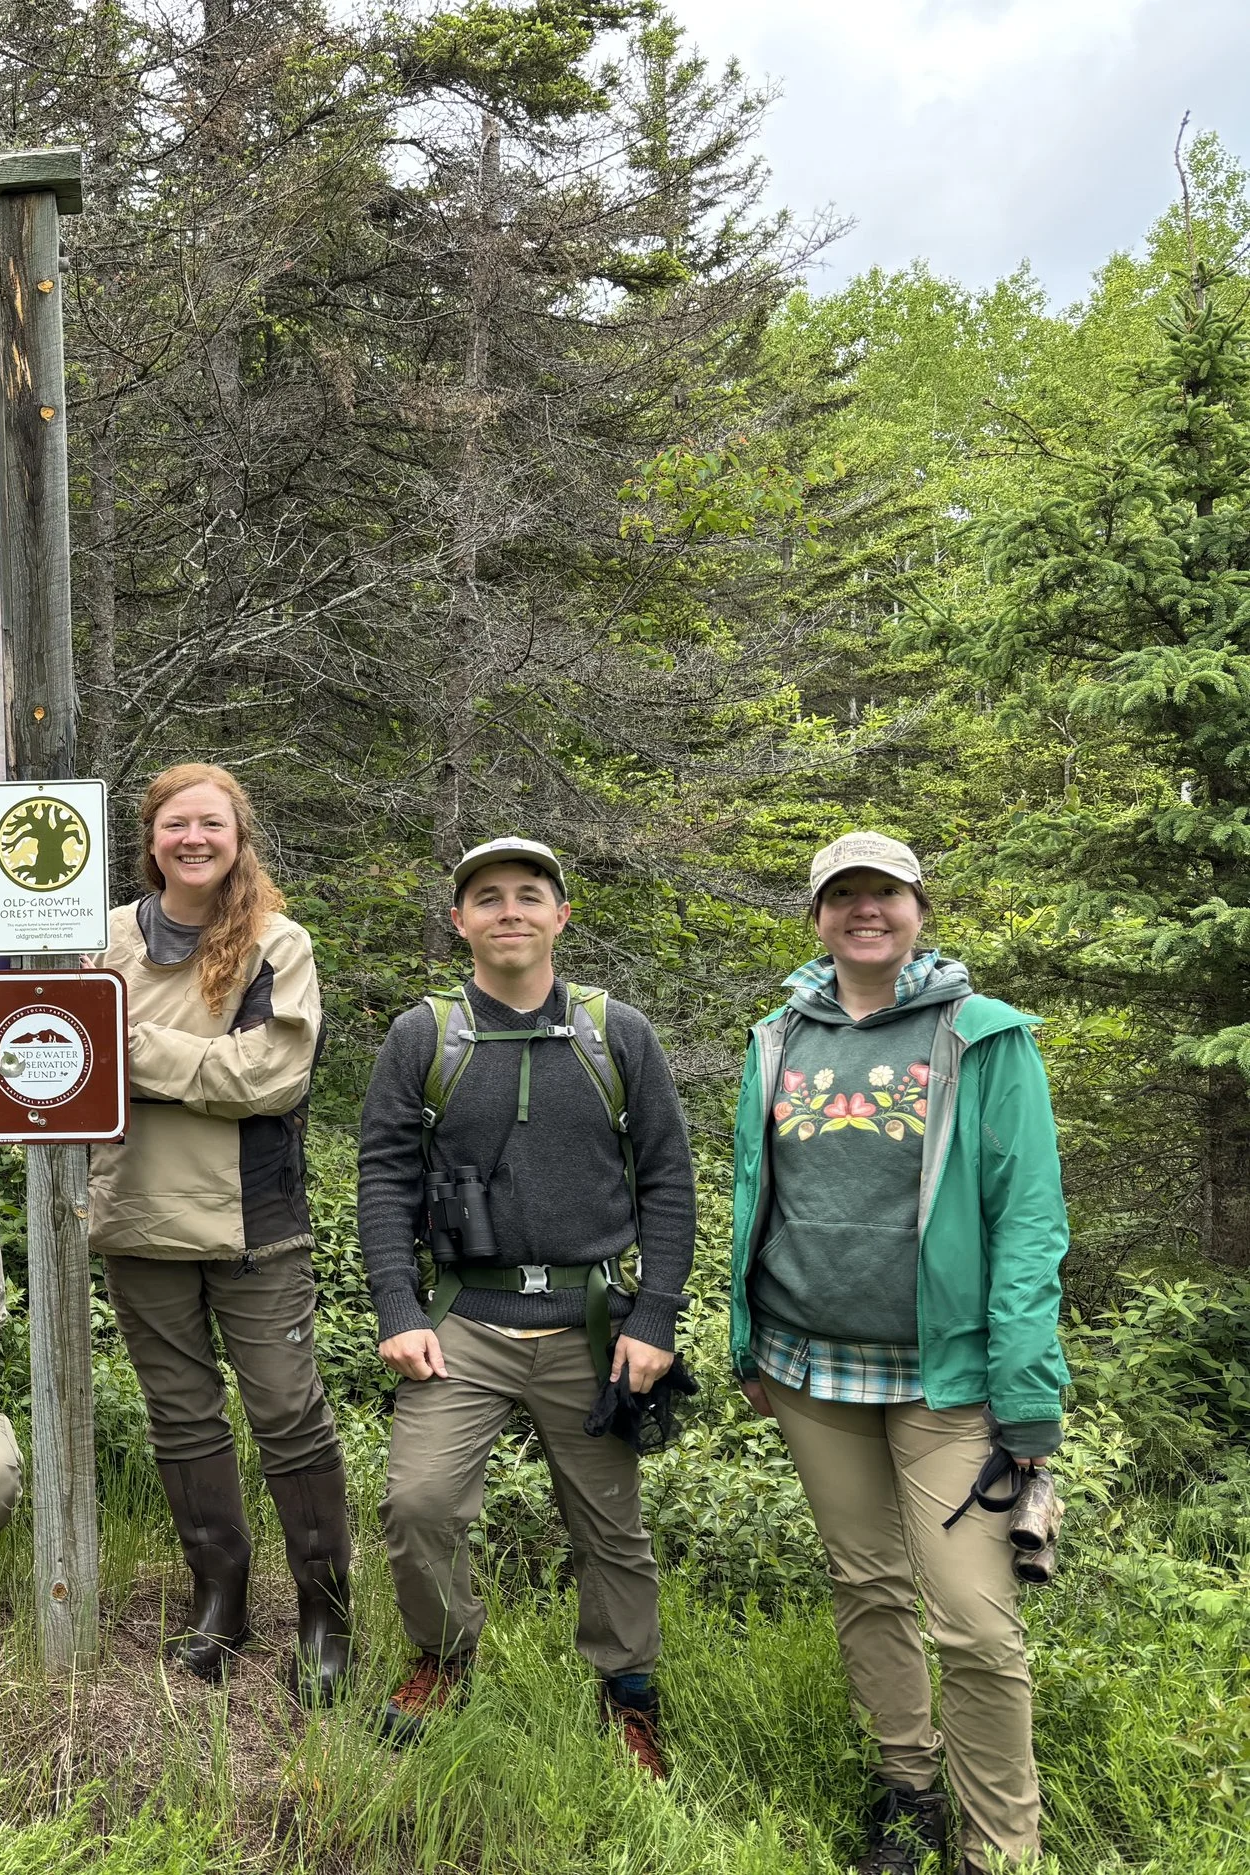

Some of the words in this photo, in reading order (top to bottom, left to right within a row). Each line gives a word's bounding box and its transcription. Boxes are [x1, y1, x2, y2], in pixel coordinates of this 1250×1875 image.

[3, 897, 80, 908] OLD-GROWTH
[37, 908, 94, 918] NETWORK
[16, 932, 73, 940] oldgrowthforest.net
[13, 1011, 24, 1021] AND
[49, 1008, 84, 1035] PARTNERSHIP
[35, 1051, 41, 1059] &
[43, 1050, 79, 1059] WATER
[26, 1060, 78, 1069] SERVATION
[28, 1070, 57, 1079] FUND
[6, 1086, 35, 1105] NATIONAL
[56, 1085, 79, 1102] SERVICE
